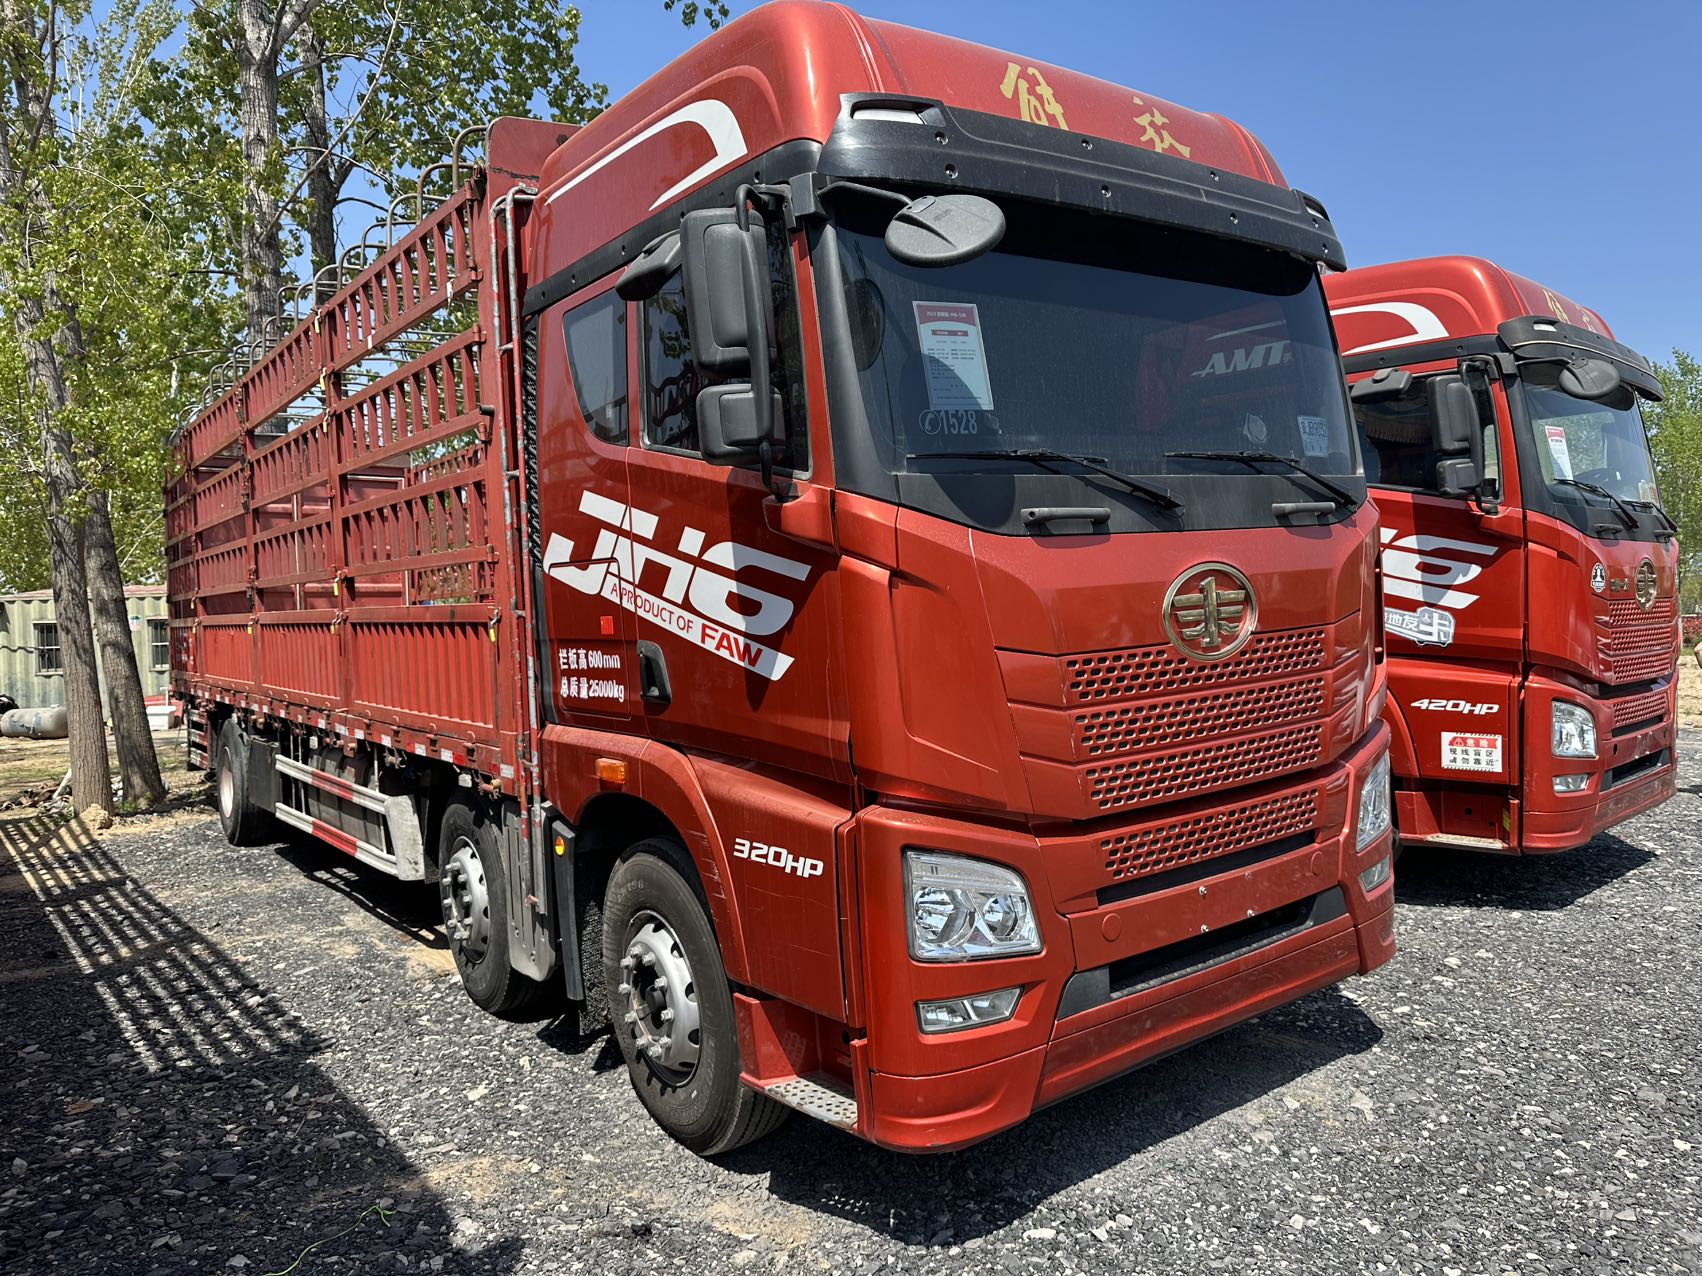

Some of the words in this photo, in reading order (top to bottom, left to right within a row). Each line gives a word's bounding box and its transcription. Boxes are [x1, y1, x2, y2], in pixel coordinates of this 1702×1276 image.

[1190, 340, 1291, 378] AMT
[939, 410, 978, 435] 1528
[610, 582, 620, 596] A
[620, 584, 675, 626] PRODUCT
[676, 606, 694, 635] OF
[700, 622, 764, 668] FAW
[1410, 698, 1500, 715] 420HP
[733, 837, 824, 878] 320HP
